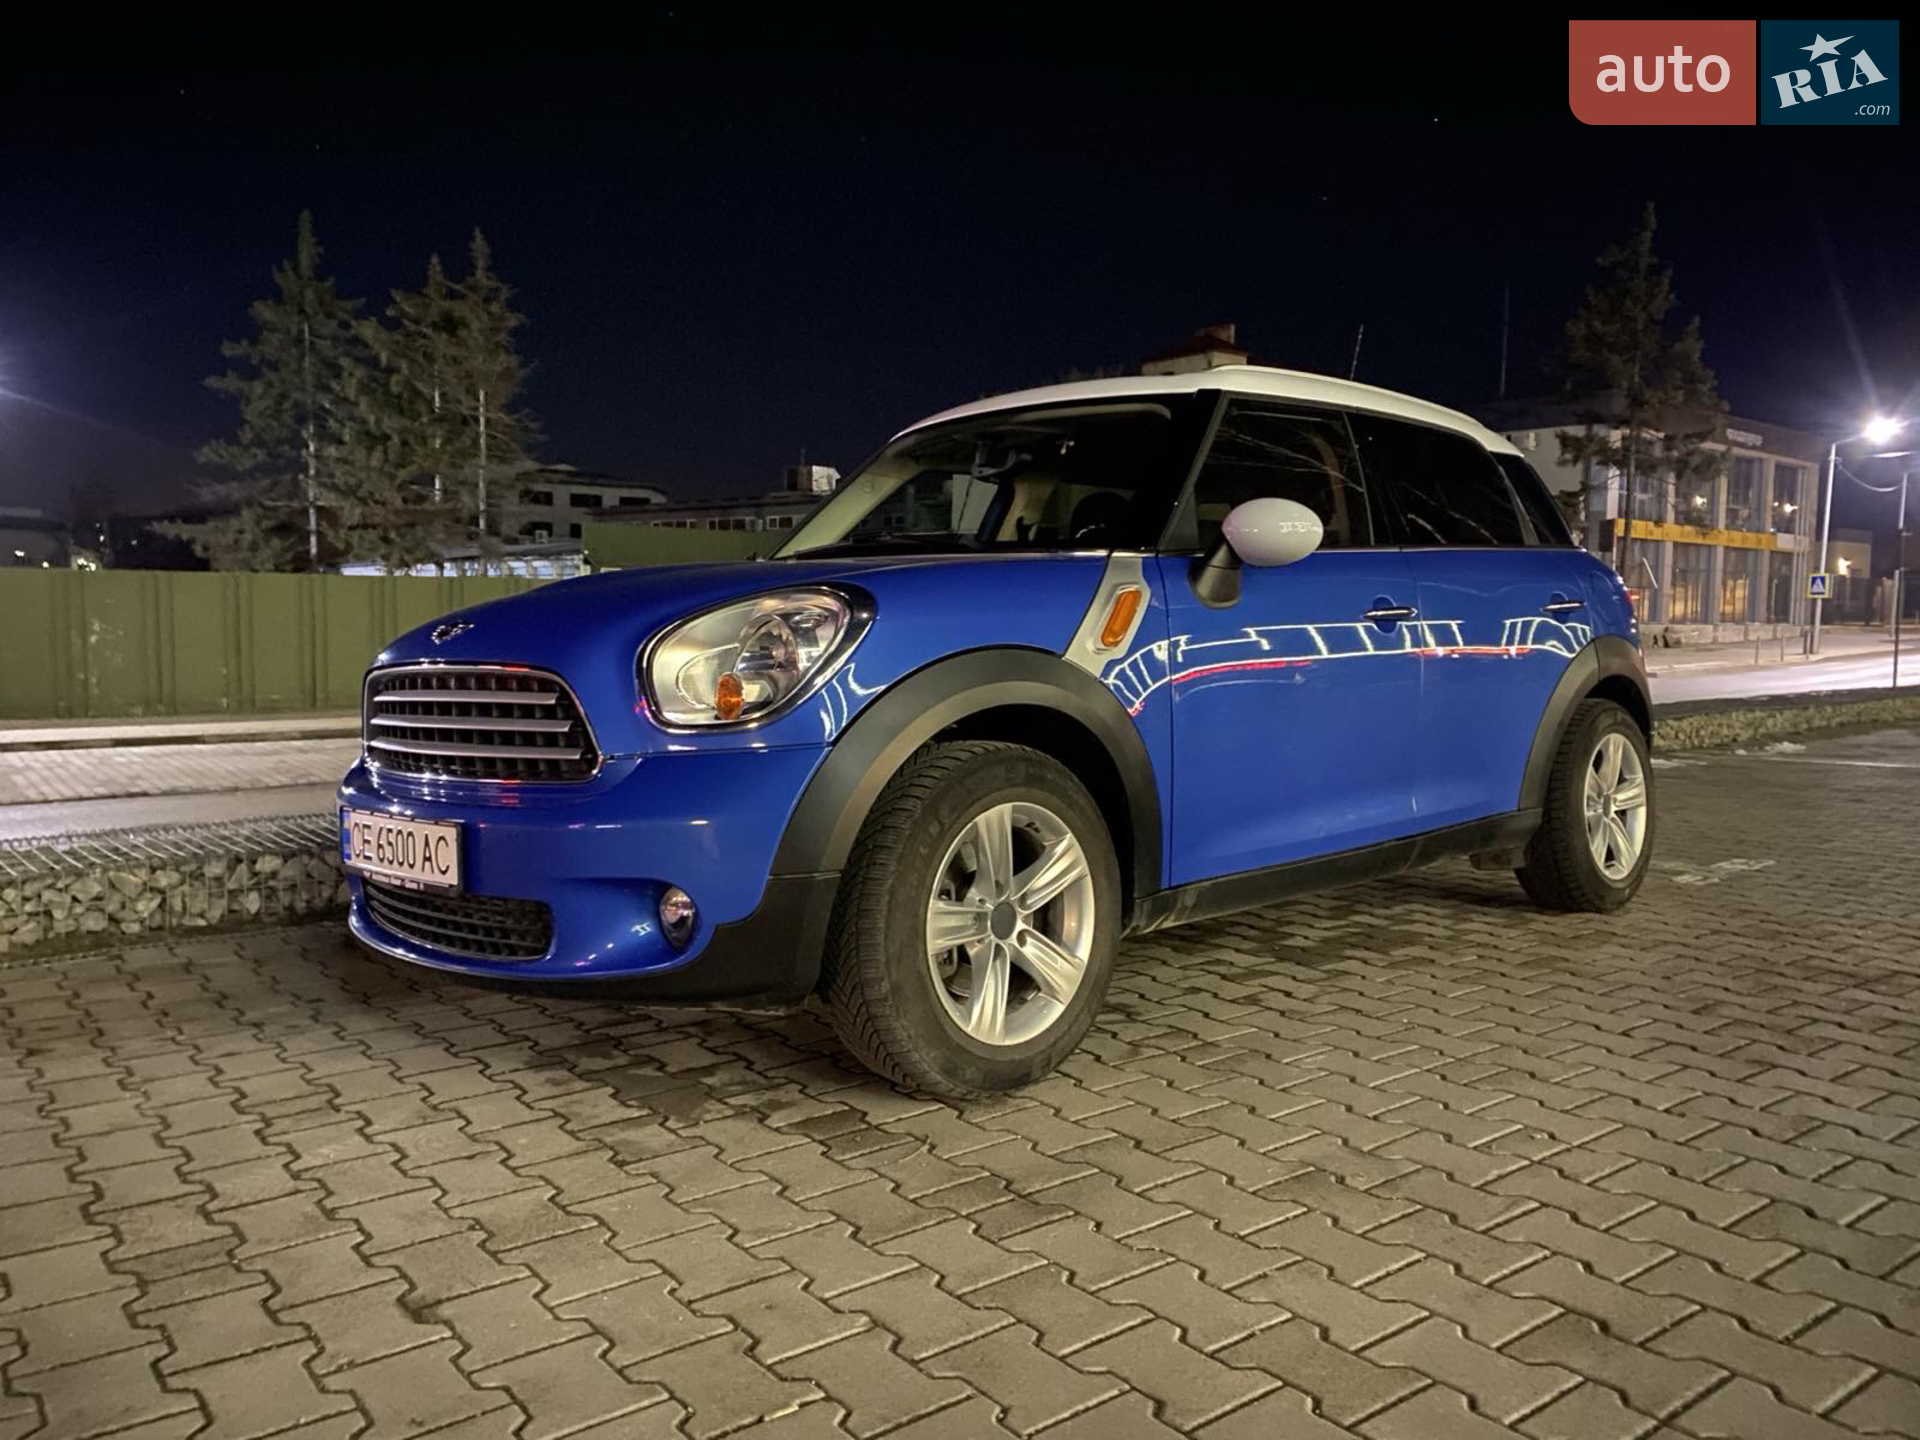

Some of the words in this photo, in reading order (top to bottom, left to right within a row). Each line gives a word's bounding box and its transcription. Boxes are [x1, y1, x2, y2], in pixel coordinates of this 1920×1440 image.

[352, 821, 374, 861] CE
[377, 825, 416, 869] 6500
[421, 831, 450, 875] AC
